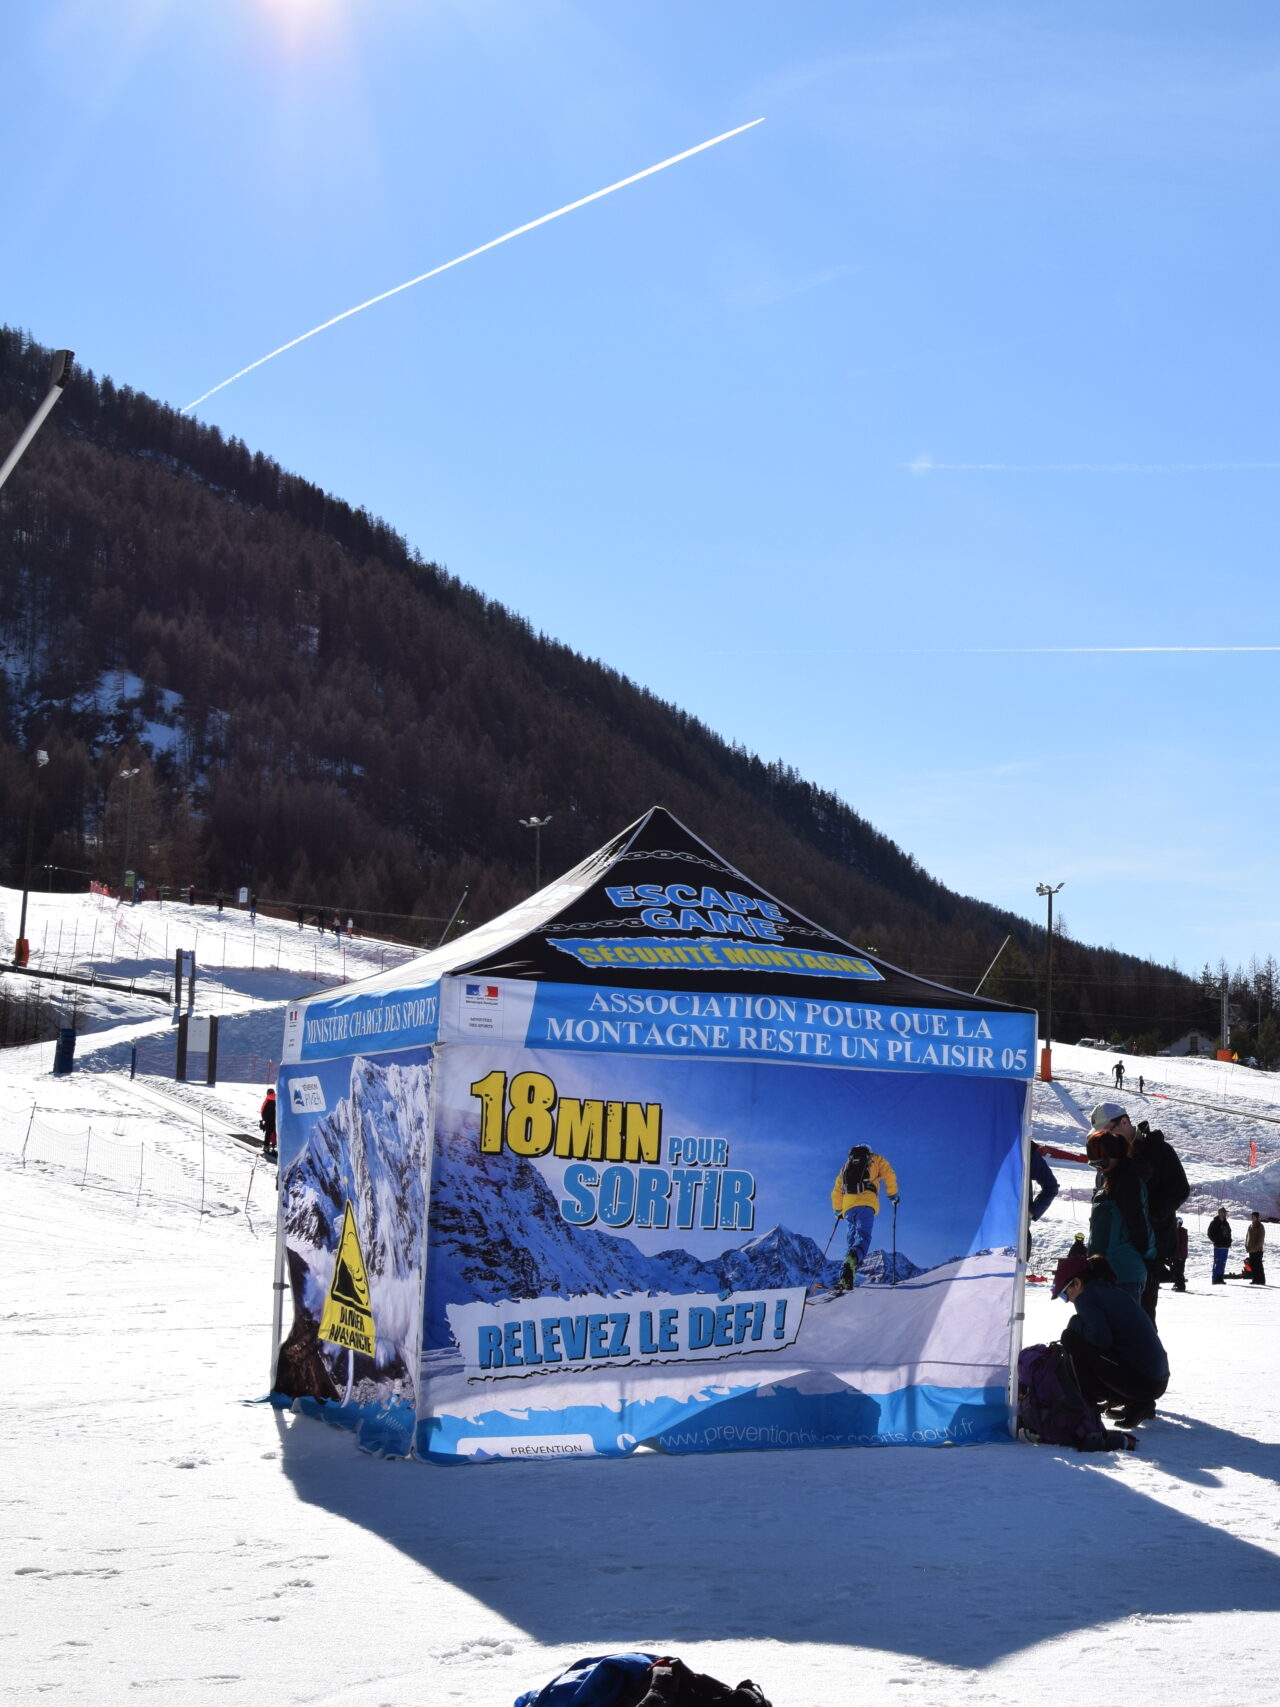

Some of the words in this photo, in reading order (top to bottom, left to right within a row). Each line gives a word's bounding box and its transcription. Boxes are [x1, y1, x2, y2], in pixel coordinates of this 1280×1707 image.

[604, 884, 790, 923] ESCAPE
[640, 908, 785, 942] GAME
[576, 944, 723, 965] SÉCURITÉ
[721, 947, 874, 976] MONTAGNE
[305, 1009, 350, 1045] MINISTÈRE
[349, 999, 384, 1038] CHARGÉ
[383, 1005, 401, 1033] DES
[402, 997, 438, 1030] SPORTS
[587, 992, 797, 1022] ASSOCIATION
[804, 1002, 885, 1031] POUR
[890, 1011, 949, 1038] QUE
[955, 1016, 993, 1039] LA
[545, 1018, 730, 1049] MONTAGNE
[739, 1026, 832, 1056] RESTE
[840, 1035, 879, 1061] UN
[887, 1039, 995, 1069] PLAISIR
[1001, 1047, 1028, 1071] 05
[667, 1136, 729, 1167] POUR
[560, 1163, 756, 1232] SORTIR
[478, 1312, 631, 1370] RELEVEZ
[638, 1308, 680, 1354] LE
[773, 1298, 789, 1340] !
[511, 1444, 583, 1455] PRÉVENTION
